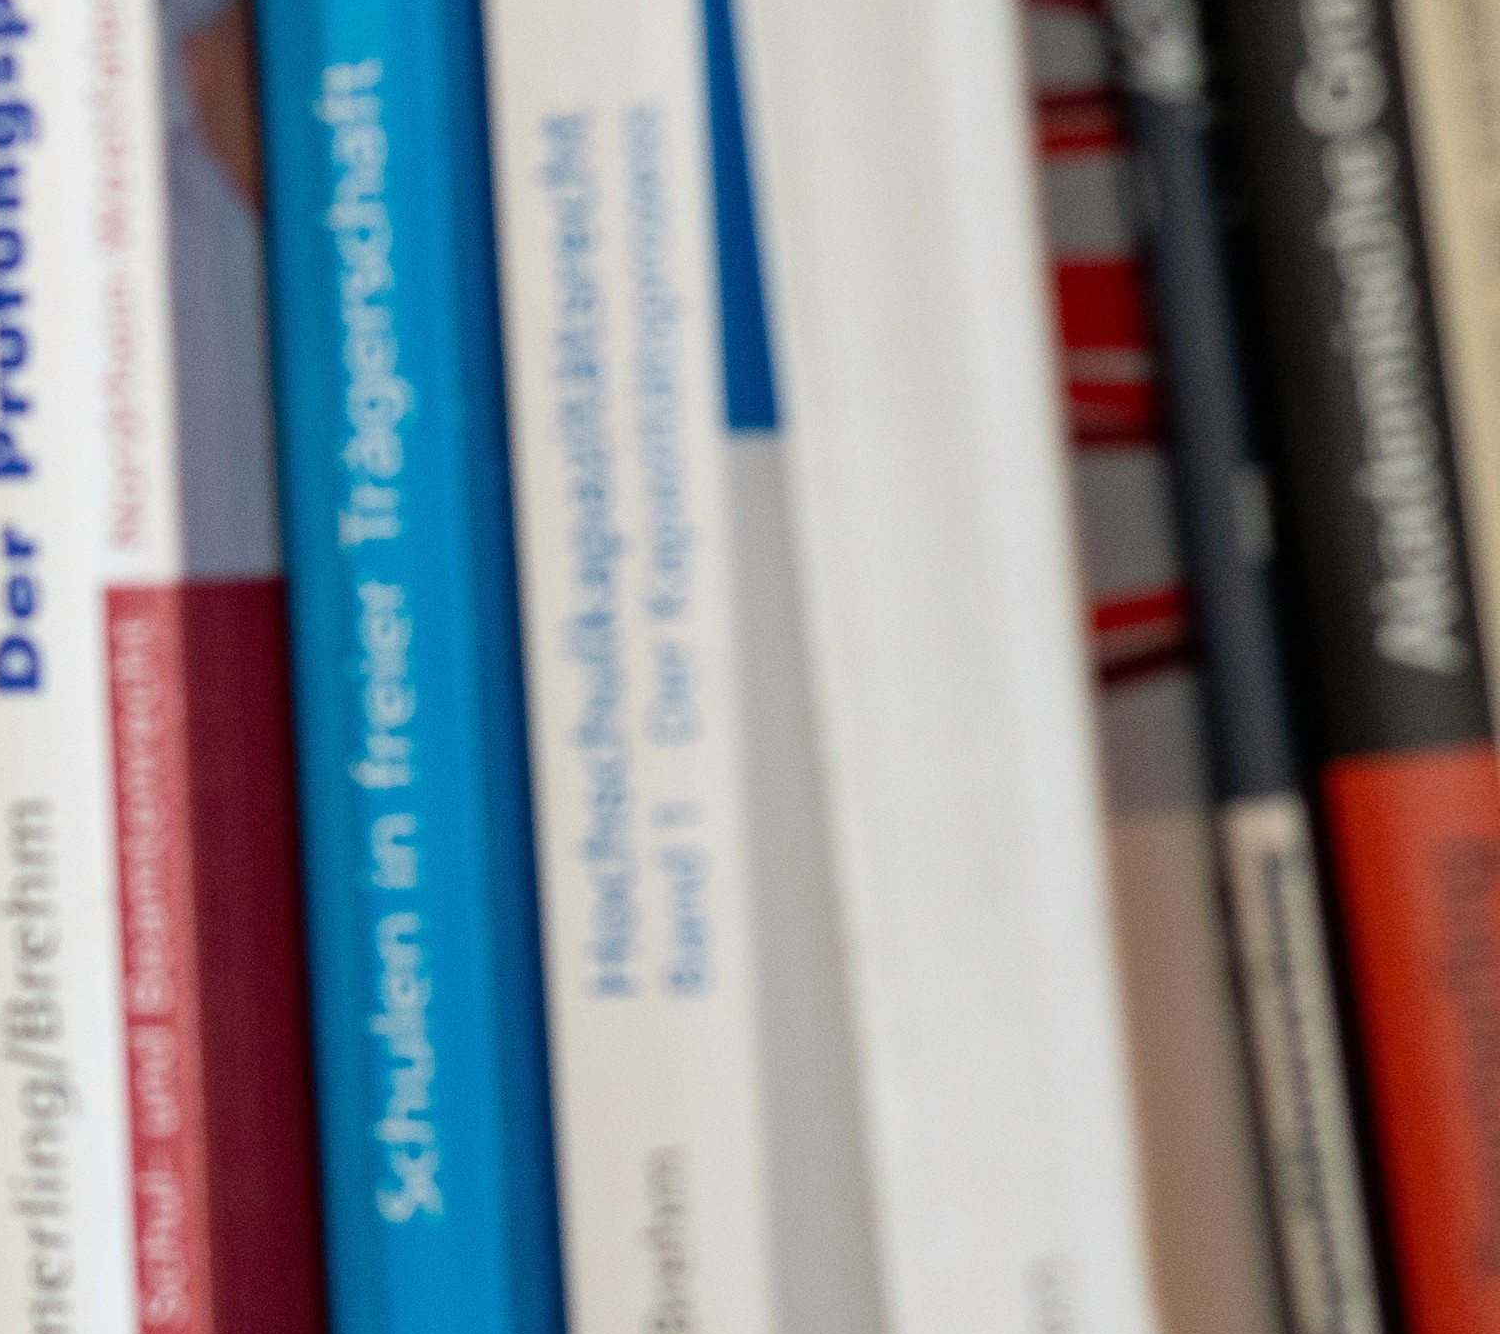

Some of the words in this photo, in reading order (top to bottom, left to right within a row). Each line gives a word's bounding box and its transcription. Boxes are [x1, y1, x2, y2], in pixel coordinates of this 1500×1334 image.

[312, 57, 416, 551] Trägerschaft
[348, 578, 420, 789] freier
[370, 813, 420, 889] in
[368, 911, 446, 1225] Schulen
